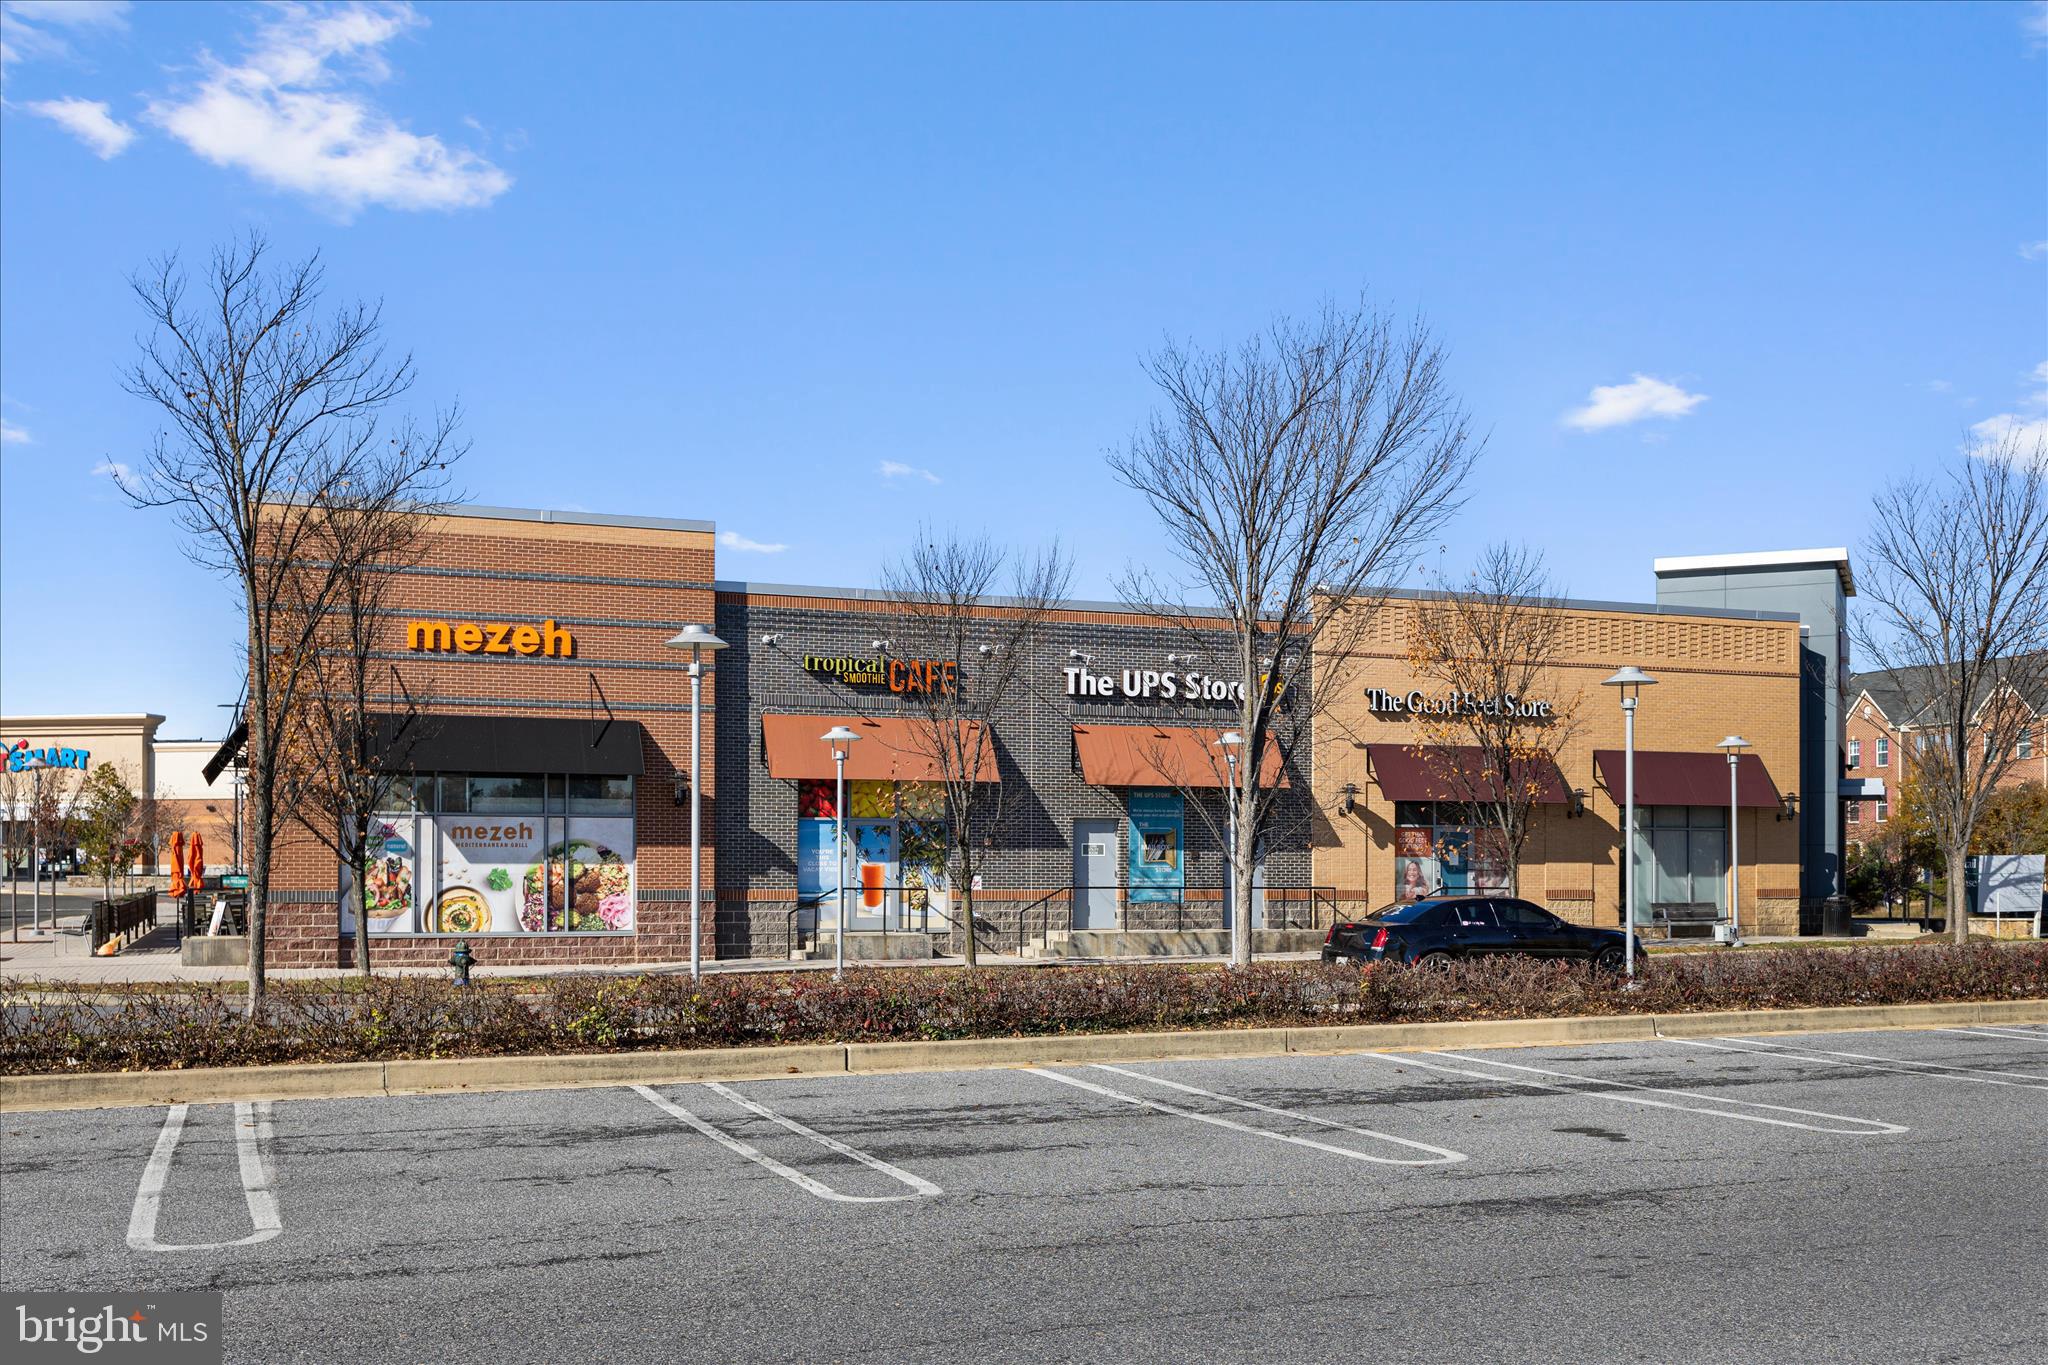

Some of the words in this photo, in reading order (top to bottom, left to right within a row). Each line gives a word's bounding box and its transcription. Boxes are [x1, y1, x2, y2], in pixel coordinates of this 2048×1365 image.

[407, 619, 572, 656] mezeh
[803, 653, 886, 675] tropical
[889, 658, 957, 694] CAFE
[843, 672, 886, 685] SMOOTHIE
[1063, 667, 1114, 696] The
[1122, 669, 1177, 699] UPS
[1185, 672, 1245, 701] Store
[1366, 687, 1403, 712] The
[1407, 690, 1459, 714] Good
[451, 822, 533, 841] mezeh
